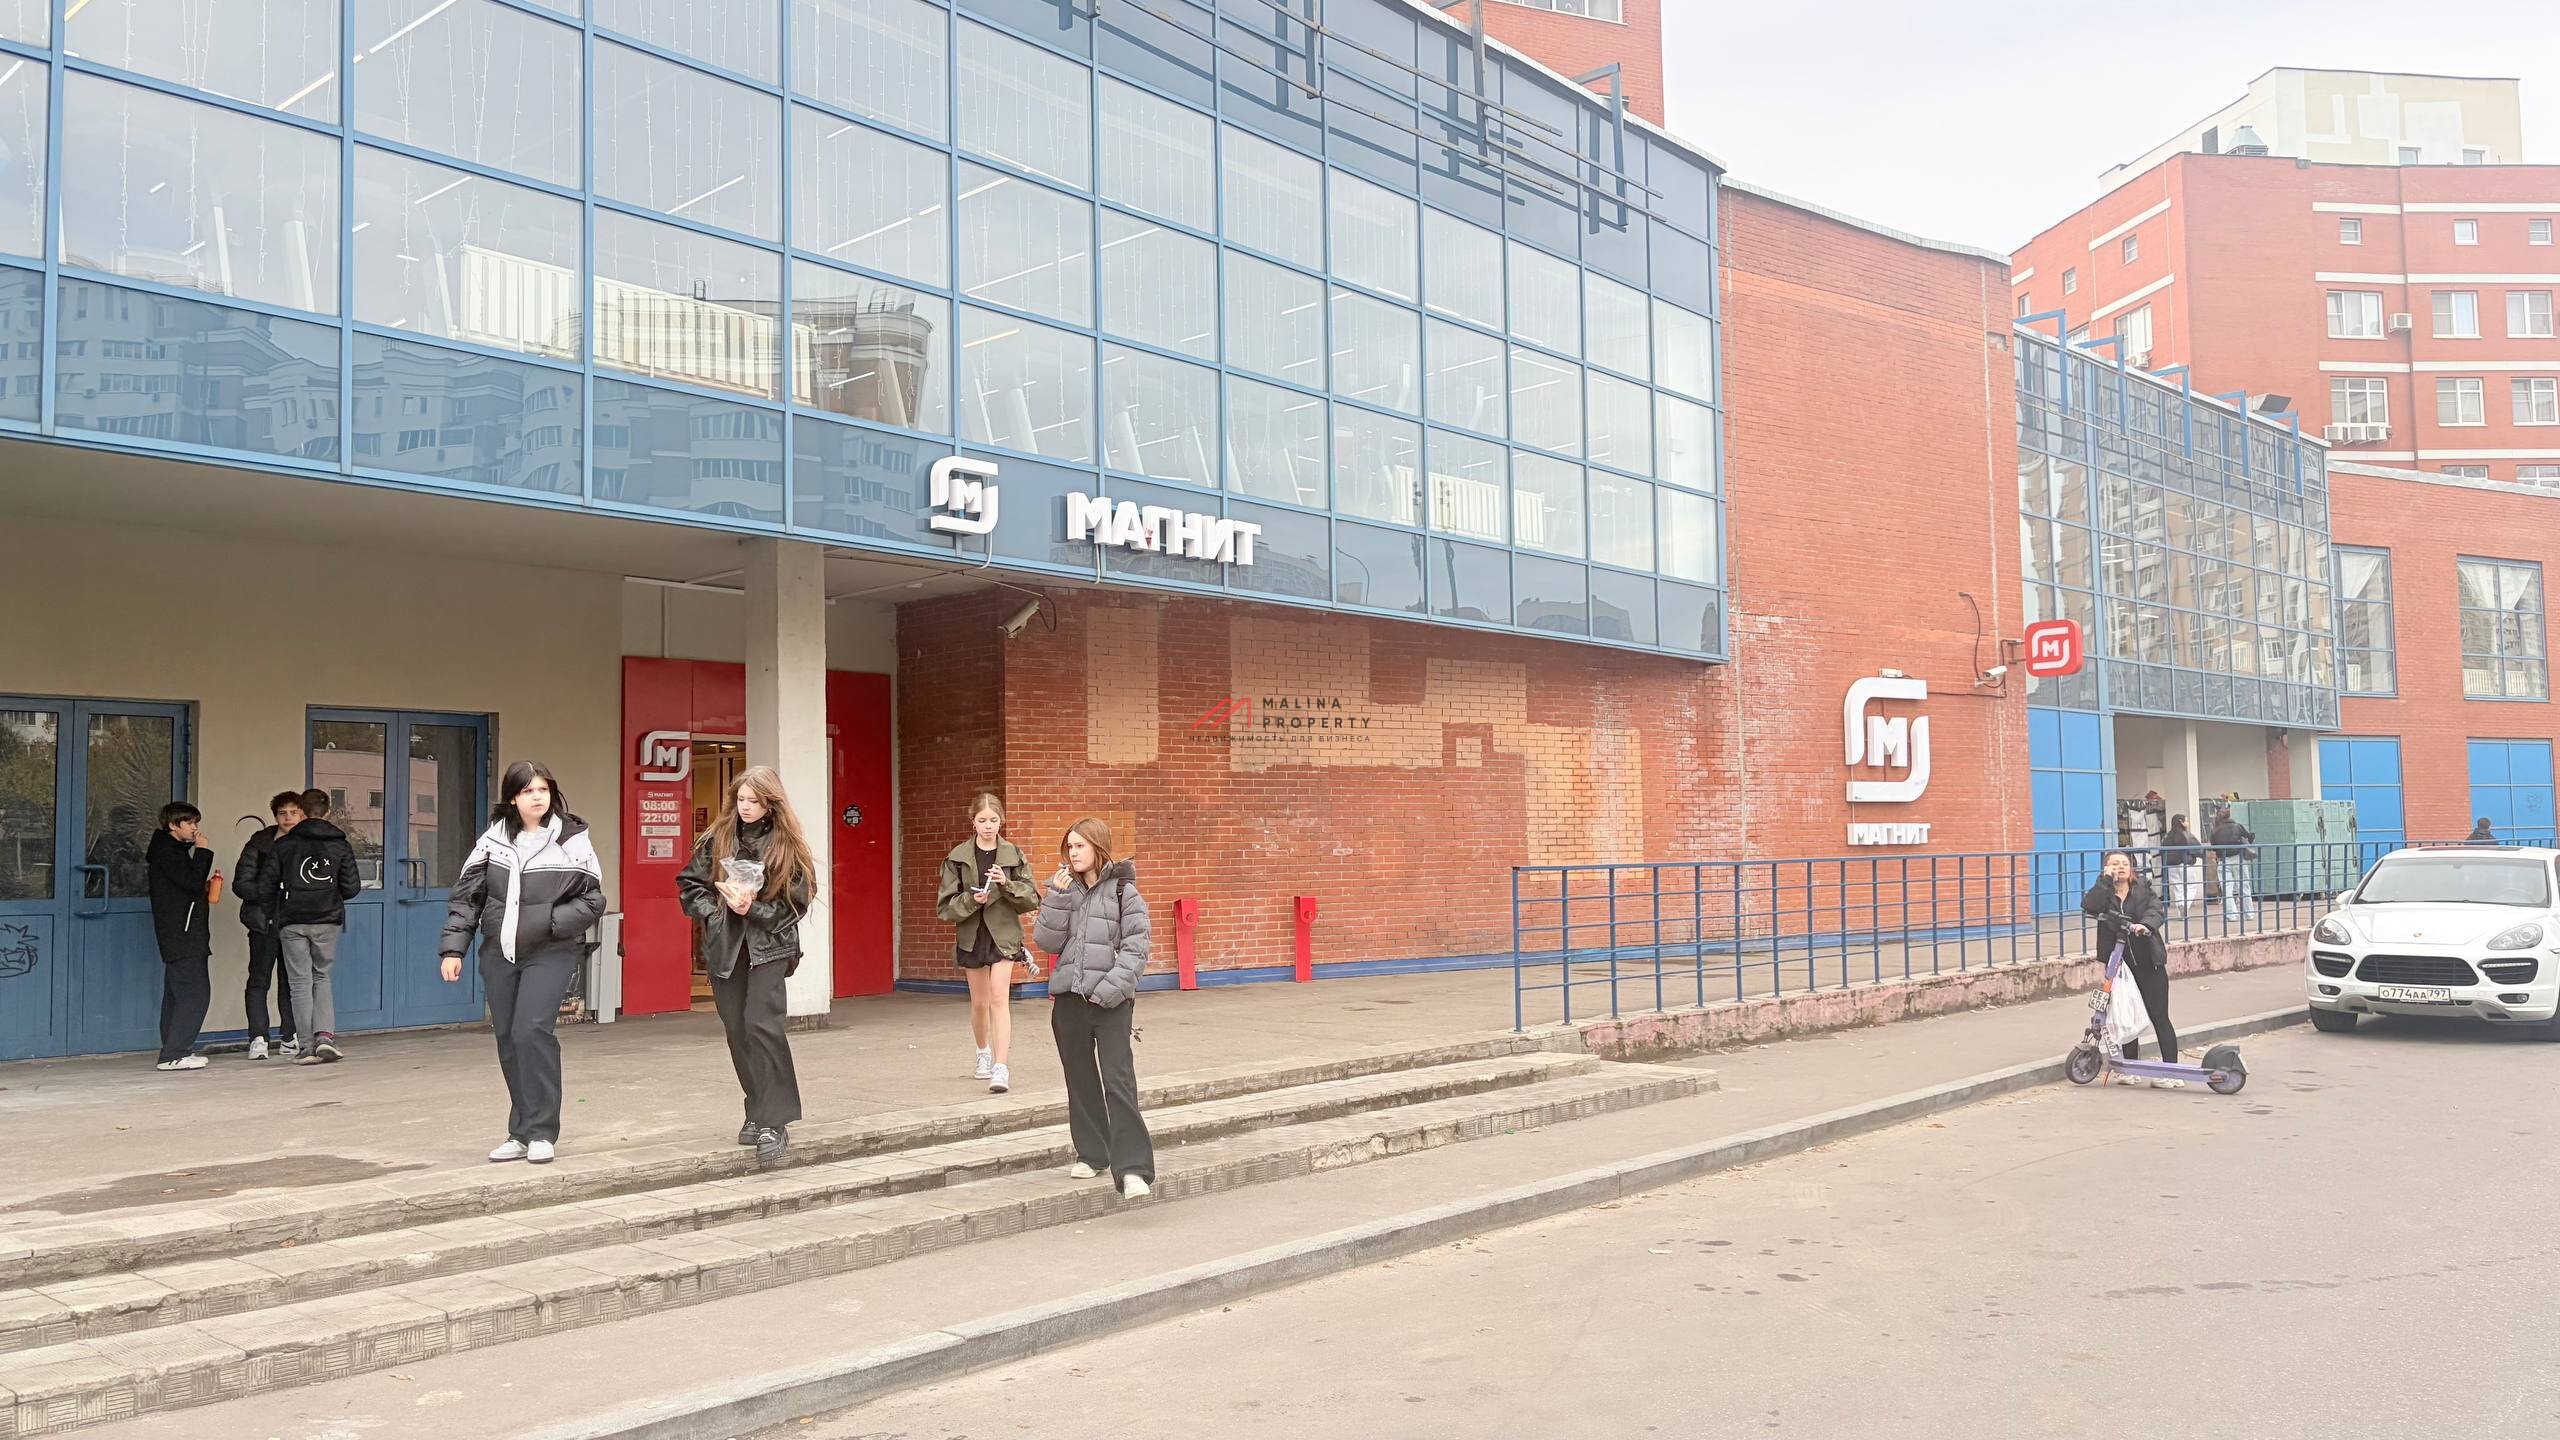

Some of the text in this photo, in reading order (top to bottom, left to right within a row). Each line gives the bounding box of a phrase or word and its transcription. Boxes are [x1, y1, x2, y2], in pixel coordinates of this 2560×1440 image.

[1067, 491, 1262, 566] МАГНИТ
[643, 800, 675, 811] 08:00
[644, 813, 677, 822] 22:00
[1847, 823, 1932, 845] МАГНИТ
